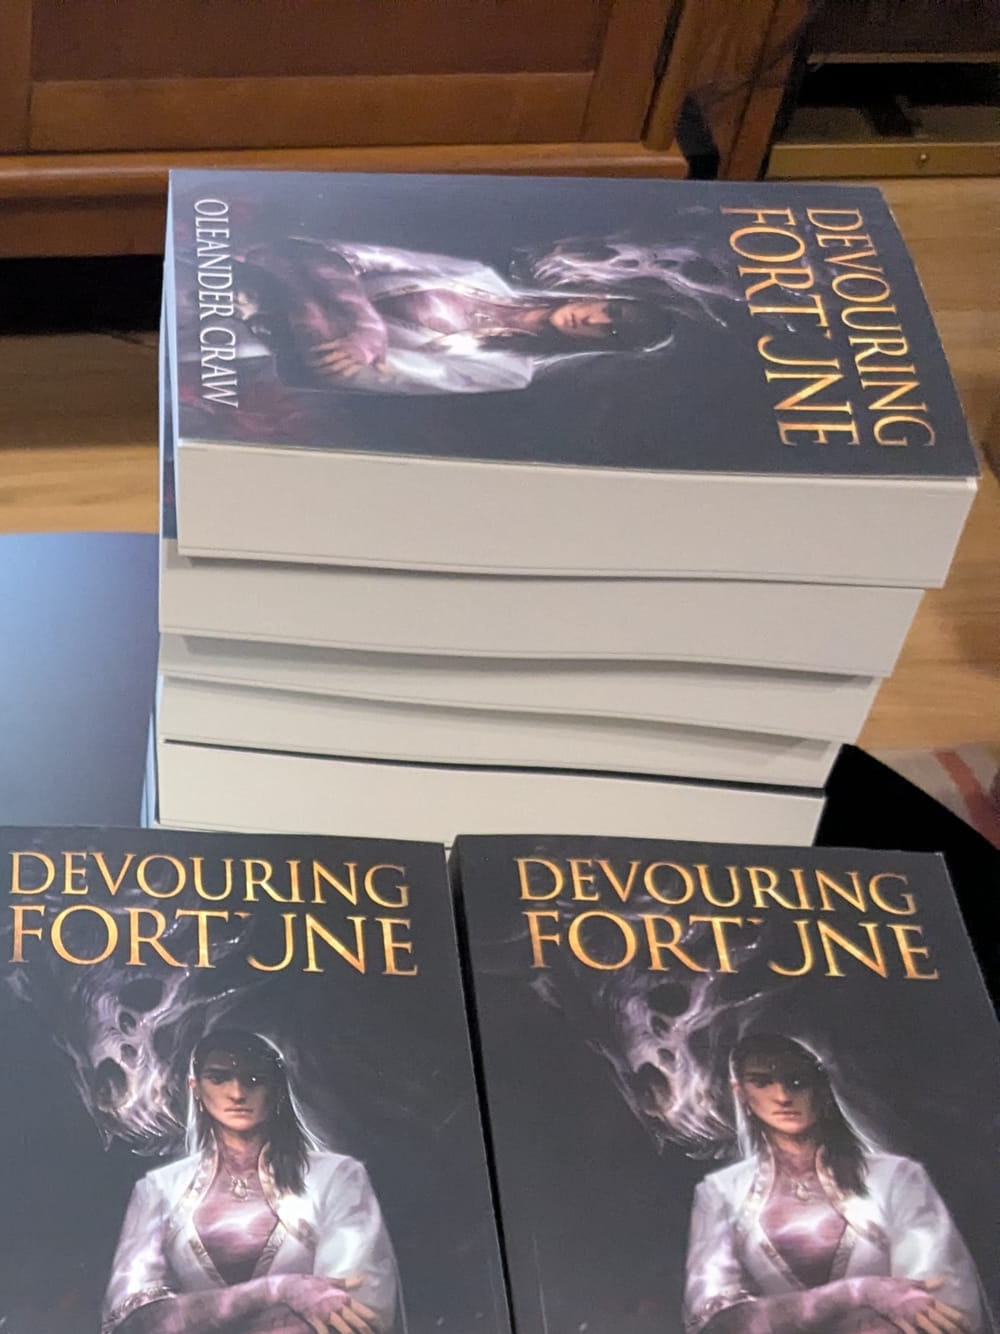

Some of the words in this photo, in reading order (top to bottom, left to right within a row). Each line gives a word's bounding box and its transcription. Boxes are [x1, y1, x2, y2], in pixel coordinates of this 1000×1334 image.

[194, 198, 234, 321] OLEANDER
[200, 326, 239, 409] CRAW
[806, 207, 936, 447] DEVOURING
[8, 851, 412, 909] DEVOURING
[517, 857, 915, 916] DEVOURING
